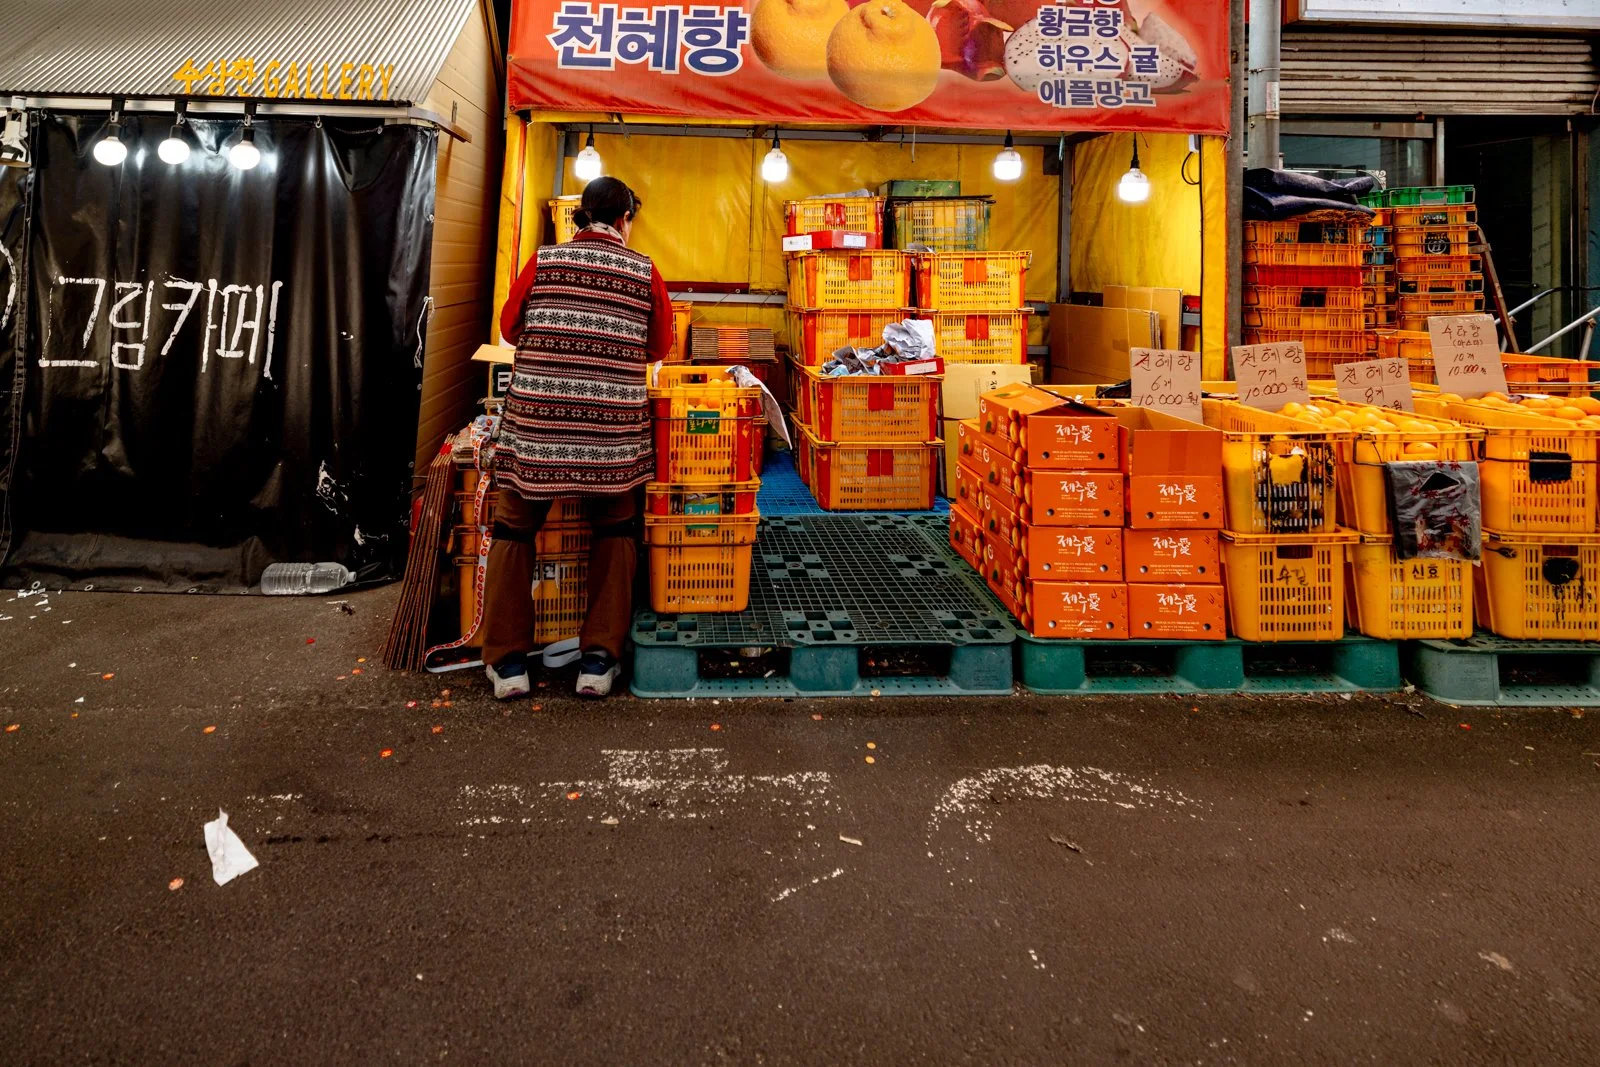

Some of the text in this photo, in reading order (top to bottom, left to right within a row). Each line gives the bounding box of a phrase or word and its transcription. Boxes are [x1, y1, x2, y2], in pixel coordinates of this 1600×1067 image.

[1037, 6, 1123, 38] 황금향
[547, 3, 750, 75] 천혜향
[1037, 44, 1159, 74] 하우스 귤
[173, 57, 394, 100] 수상한 GALLERY
[1038, 78, 1156, 108] 애플망고
[1133, 353, 1193, 372] 천혜향
[1240, 345, 1303, 368] 천혜향
[1342, 362, 1403, 385] 천혜향
[1412, 564, 1440, 580] 신효
